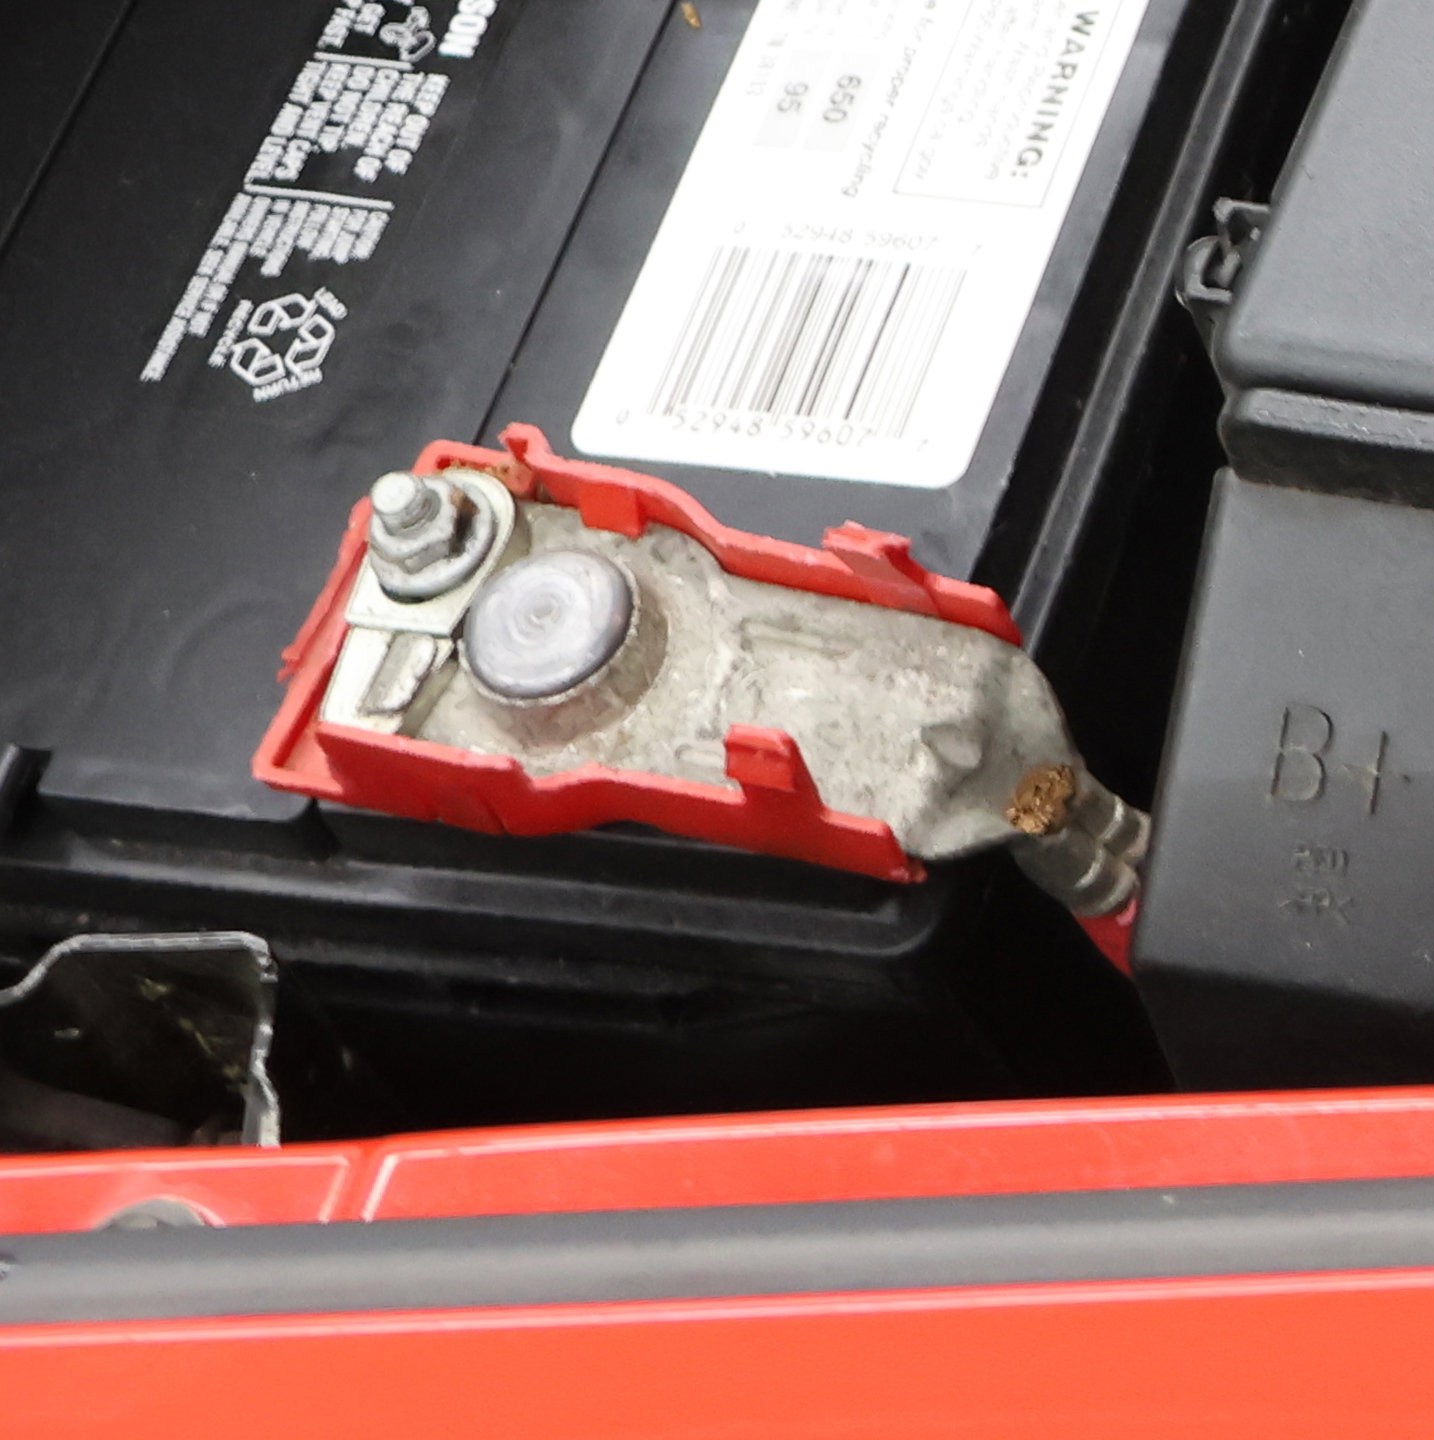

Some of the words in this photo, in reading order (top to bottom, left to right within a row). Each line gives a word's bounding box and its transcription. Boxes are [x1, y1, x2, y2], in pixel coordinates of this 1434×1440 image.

[774, 82, 810, 112] 95
[819, 76, 864, 121] 650
[1009, 11, 1099, 179] WARNING:
